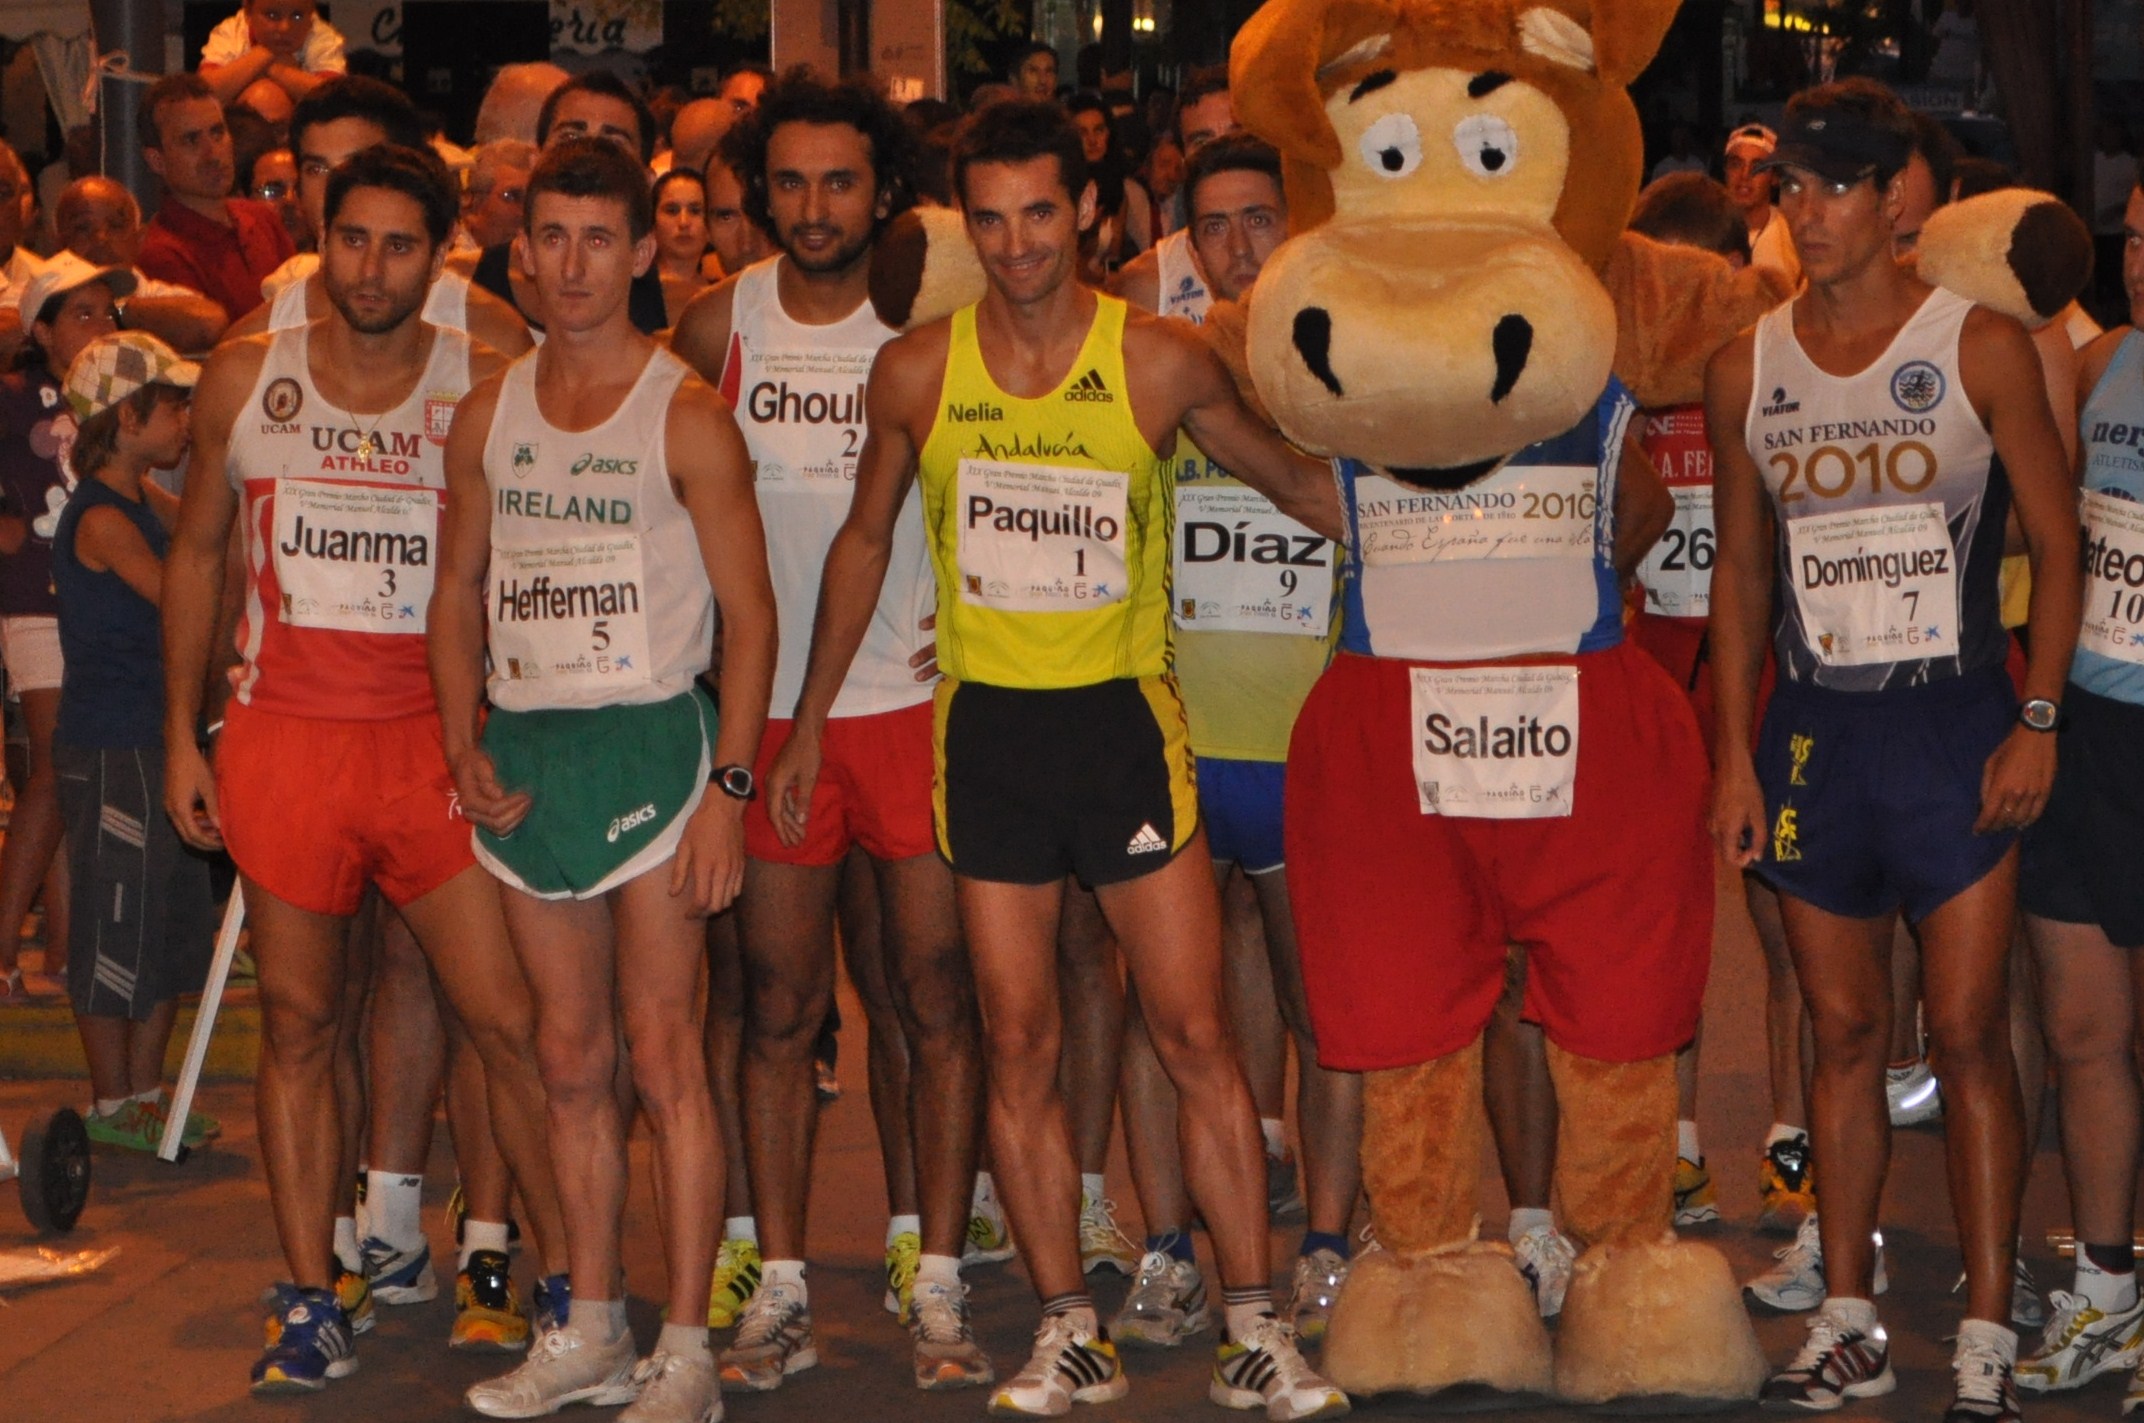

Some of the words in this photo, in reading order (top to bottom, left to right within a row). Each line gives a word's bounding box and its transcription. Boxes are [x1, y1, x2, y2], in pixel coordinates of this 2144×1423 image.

[1064, 389, 1114, 403] adidas
[1762, 402, 1801, 417] VIATOR
[948, 402, 1004, 422] Nelia
[261, 424, 302, 434] UCAM
[311, 427, 422, 459] UCAM
[841, 429, 858, 457] 2
[1764, 428, 1803, 450] SAN
[1809, 418, 1936, 443] FERNANDO
[2092, 422, 2144, 448] ner
[974, 431, 1094, 462] Andalucía
[321, 455, 411, 475] ATHLEO
[592, 458, 638, 475] asics
[1769, 440, 1938, 503] 2010
[498, 489, 632, 525] IRELAND
[968, 495, 1118, 542] Paquillo
[1357, 501, 1391, 519] SAN
[1397, 492, 1516, 515] FERNANDO
[1443, 513, 1483, 522] ORTE
[281, 516, 428, 566] Juanma
[1184, 521, 1326, 567] Díaz
[1660, 527, 1716, 571] 26
[1074, 548, 1086, 577] 1
[1802, 547, 1949, 590] Domínguez
[378, 568, 397, 598] 3
[1279, 569, 1298, 598] 9
[498, 576, 639, 622] Heffernan
[1902, 591, 1920, 622] 7
[2108, 589, 2144, 625] 10
[592, 621, 611, 651] 5
[1425, 713, 1572, 759] Salaito
[621, 803, 657, 832] asics
[1126, 840, 1167, 855] adidas
